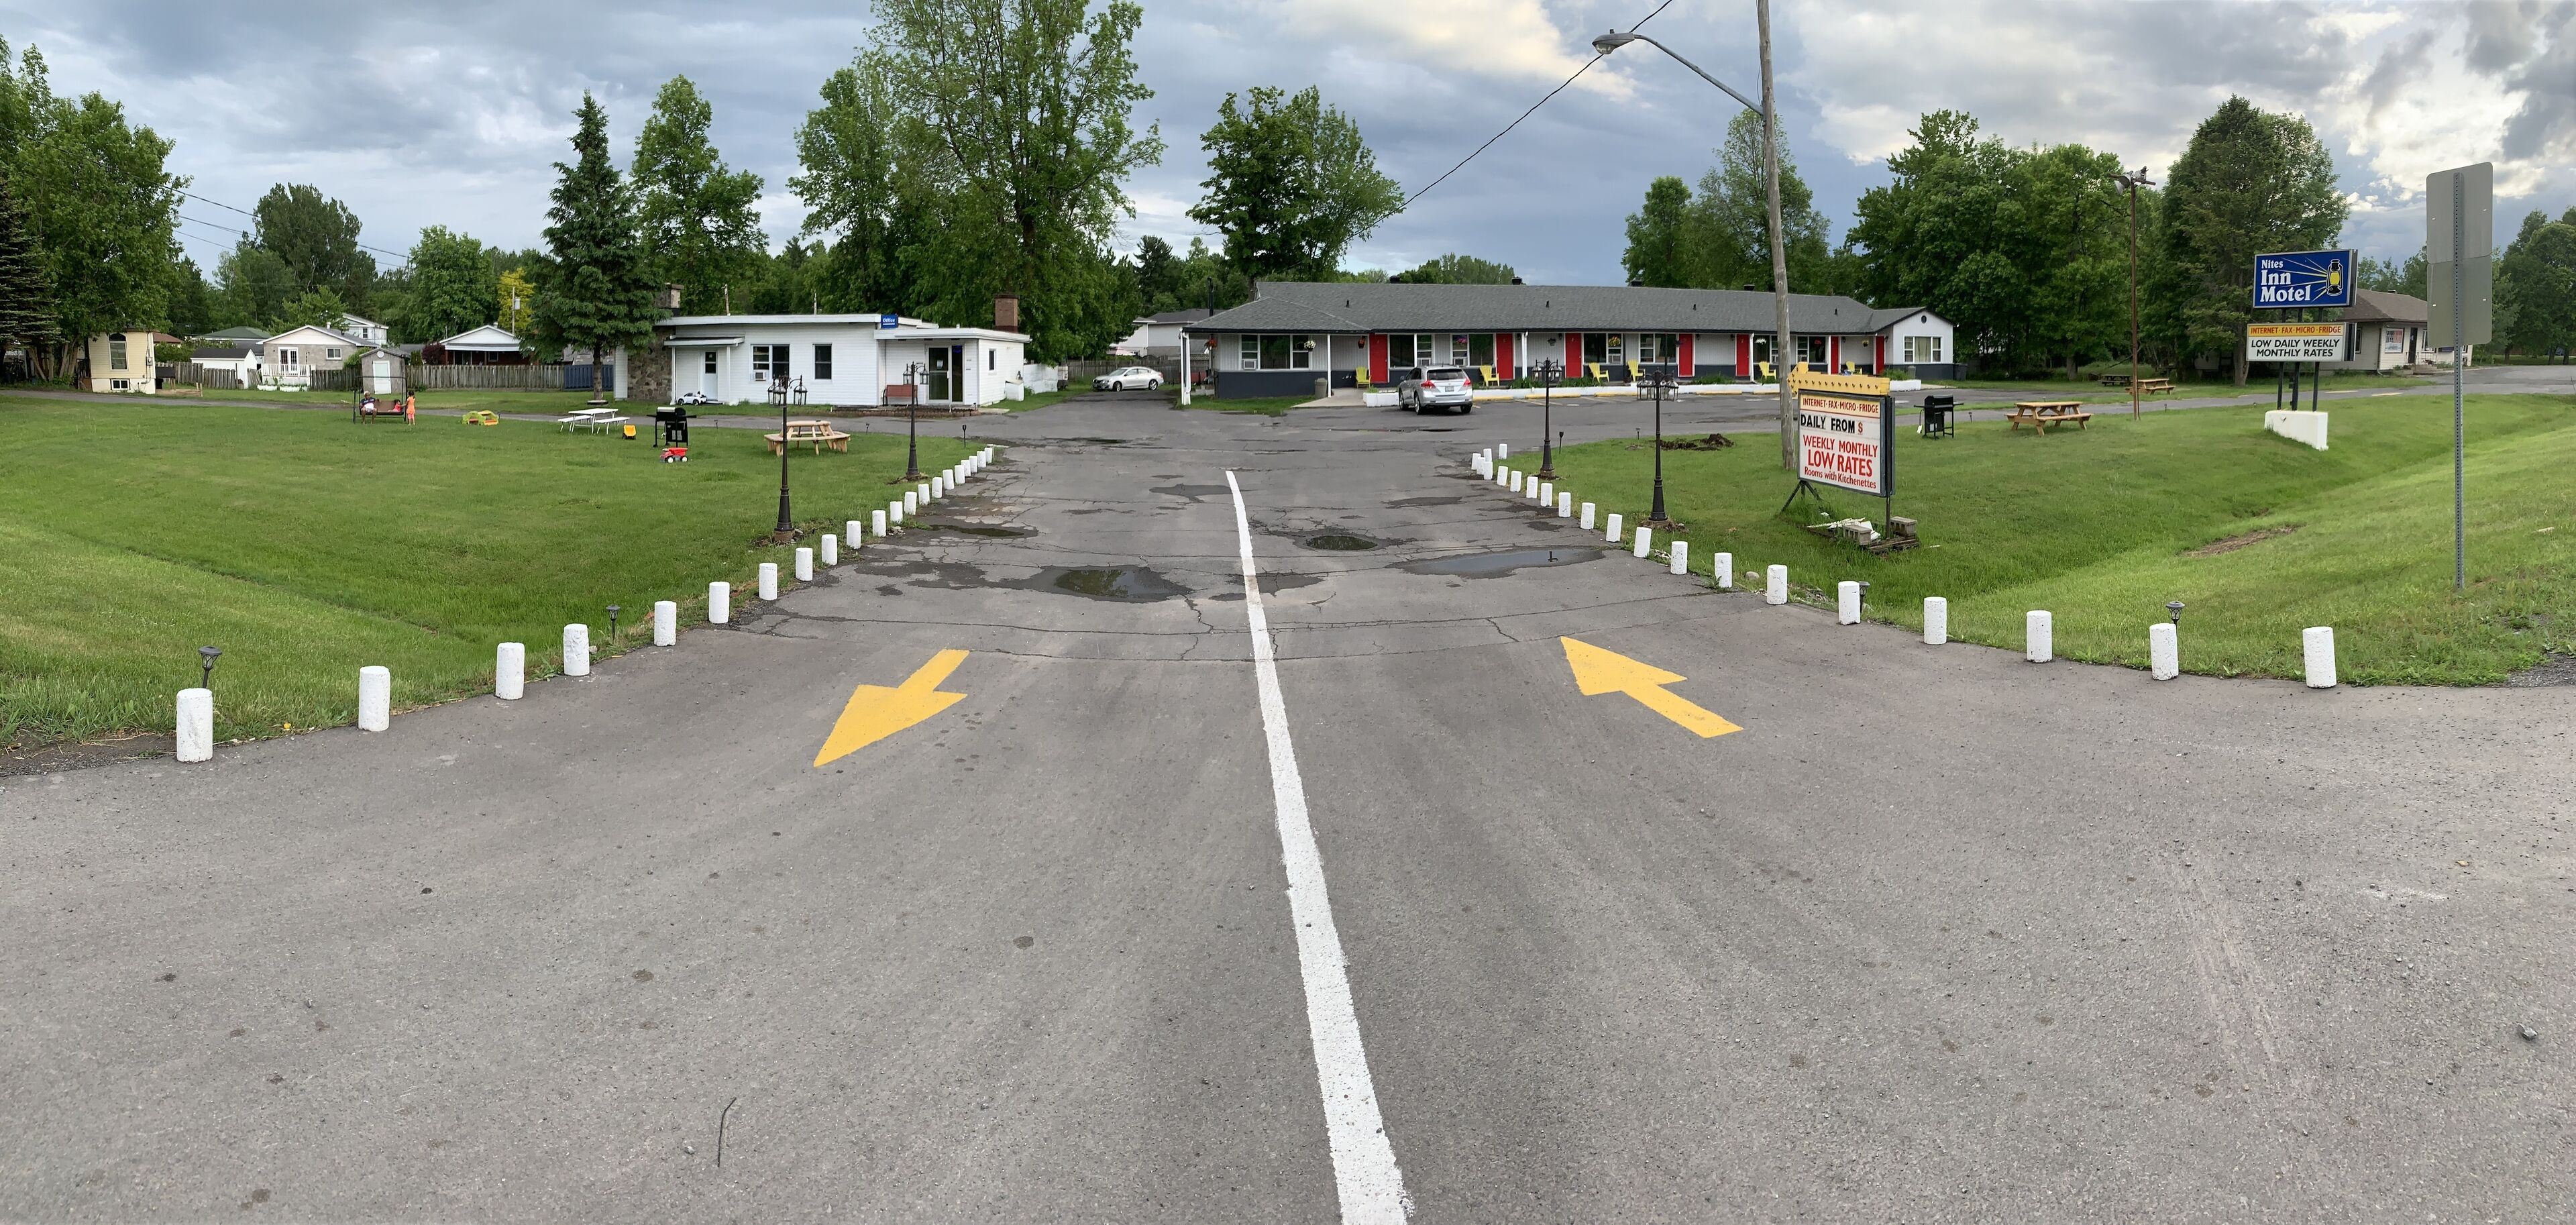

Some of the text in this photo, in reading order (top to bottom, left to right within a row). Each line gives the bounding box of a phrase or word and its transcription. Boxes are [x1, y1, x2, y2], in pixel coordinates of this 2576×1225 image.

[2261, 260, 2284, 269] Nites
[2261, 270, 2291, 286] Inn
[2260, 284, 2311, 302] Motel
[2251, 339, 2340, 348] LOW DAILY WEEKLY
[2256, 348, 2333, 357] MONTHLY RATES
[1803, 397, 1878, 413] INTERNET FAX MICRO FRIDGE
[1801, 414, 1864, 433] DAILY FROM $
[1803, 435, 1878, 458] WEEKLY MONTHLY
[1808, 449, 1872, 477] LOW RATES
[1805, 466, 1876, 489] Rooms with Kitchenettes
